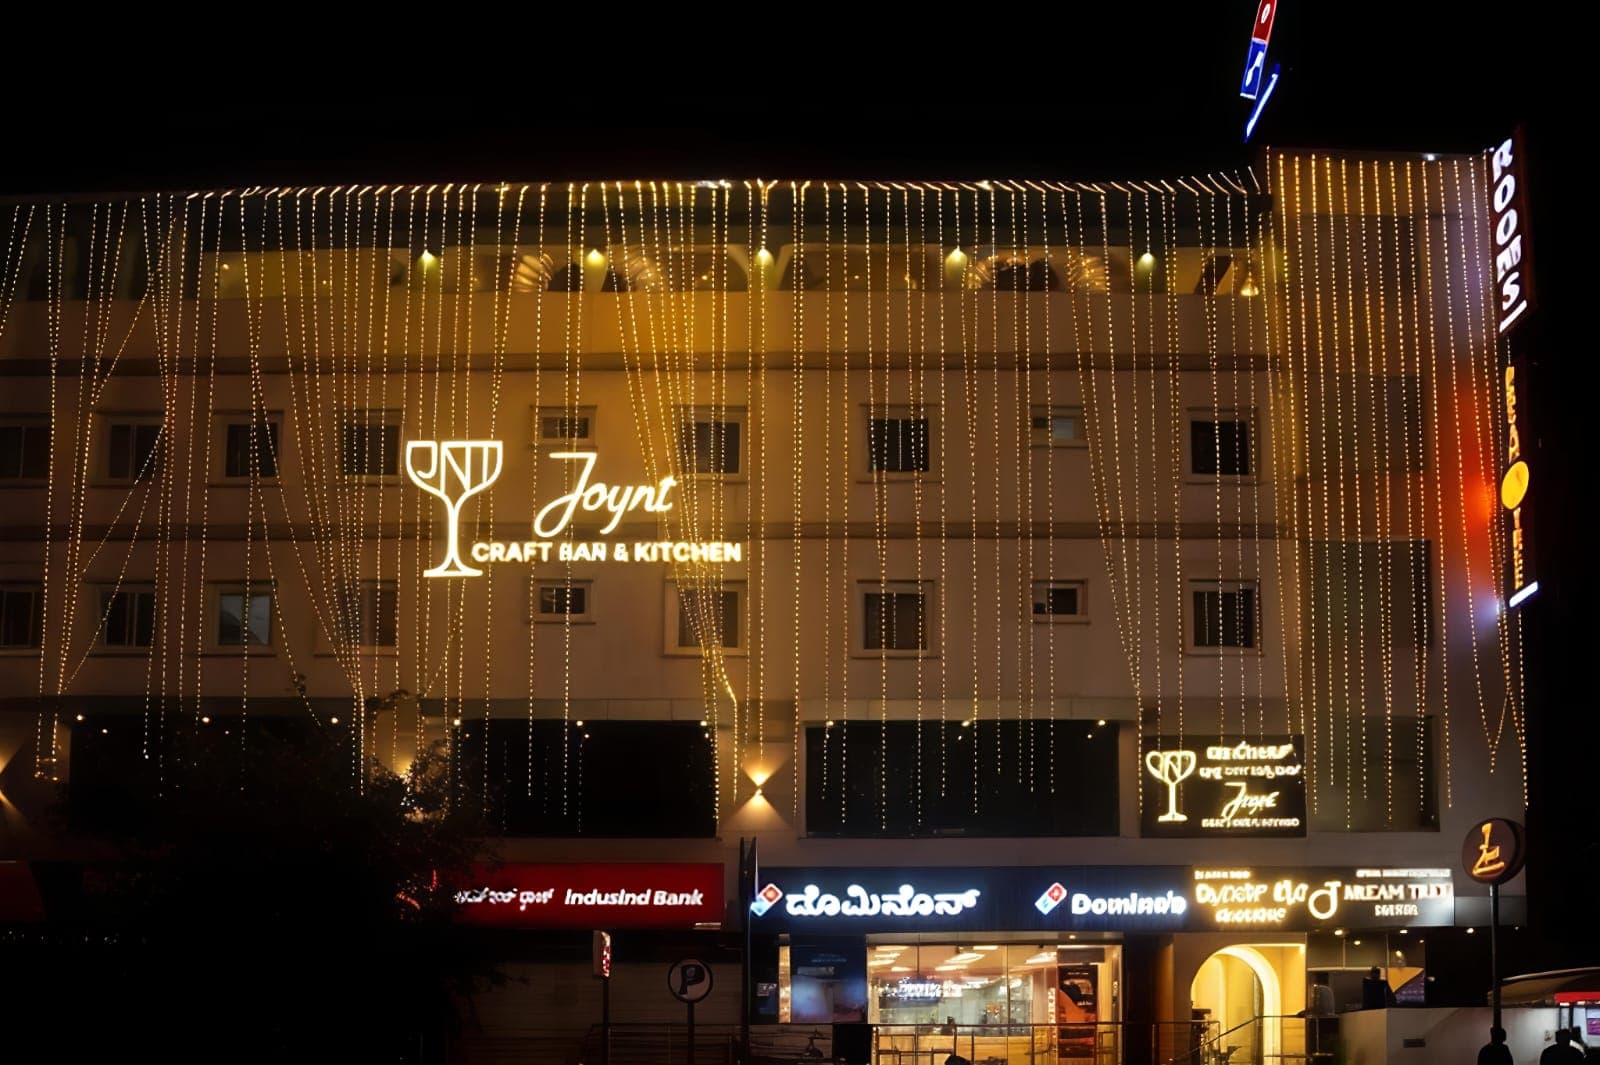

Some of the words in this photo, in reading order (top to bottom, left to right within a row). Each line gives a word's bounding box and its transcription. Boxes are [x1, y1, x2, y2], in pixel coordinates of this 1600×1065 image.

[533, 452, 677, 538] Joynt
[472, 542, 553, 562] CRAFT
[613, 543, 629, 562] &
[634, 542, 742, 562] KITCHEN
[564, 888, 652, 906] IndusInd
[653, 889, 704, 906] Bank
